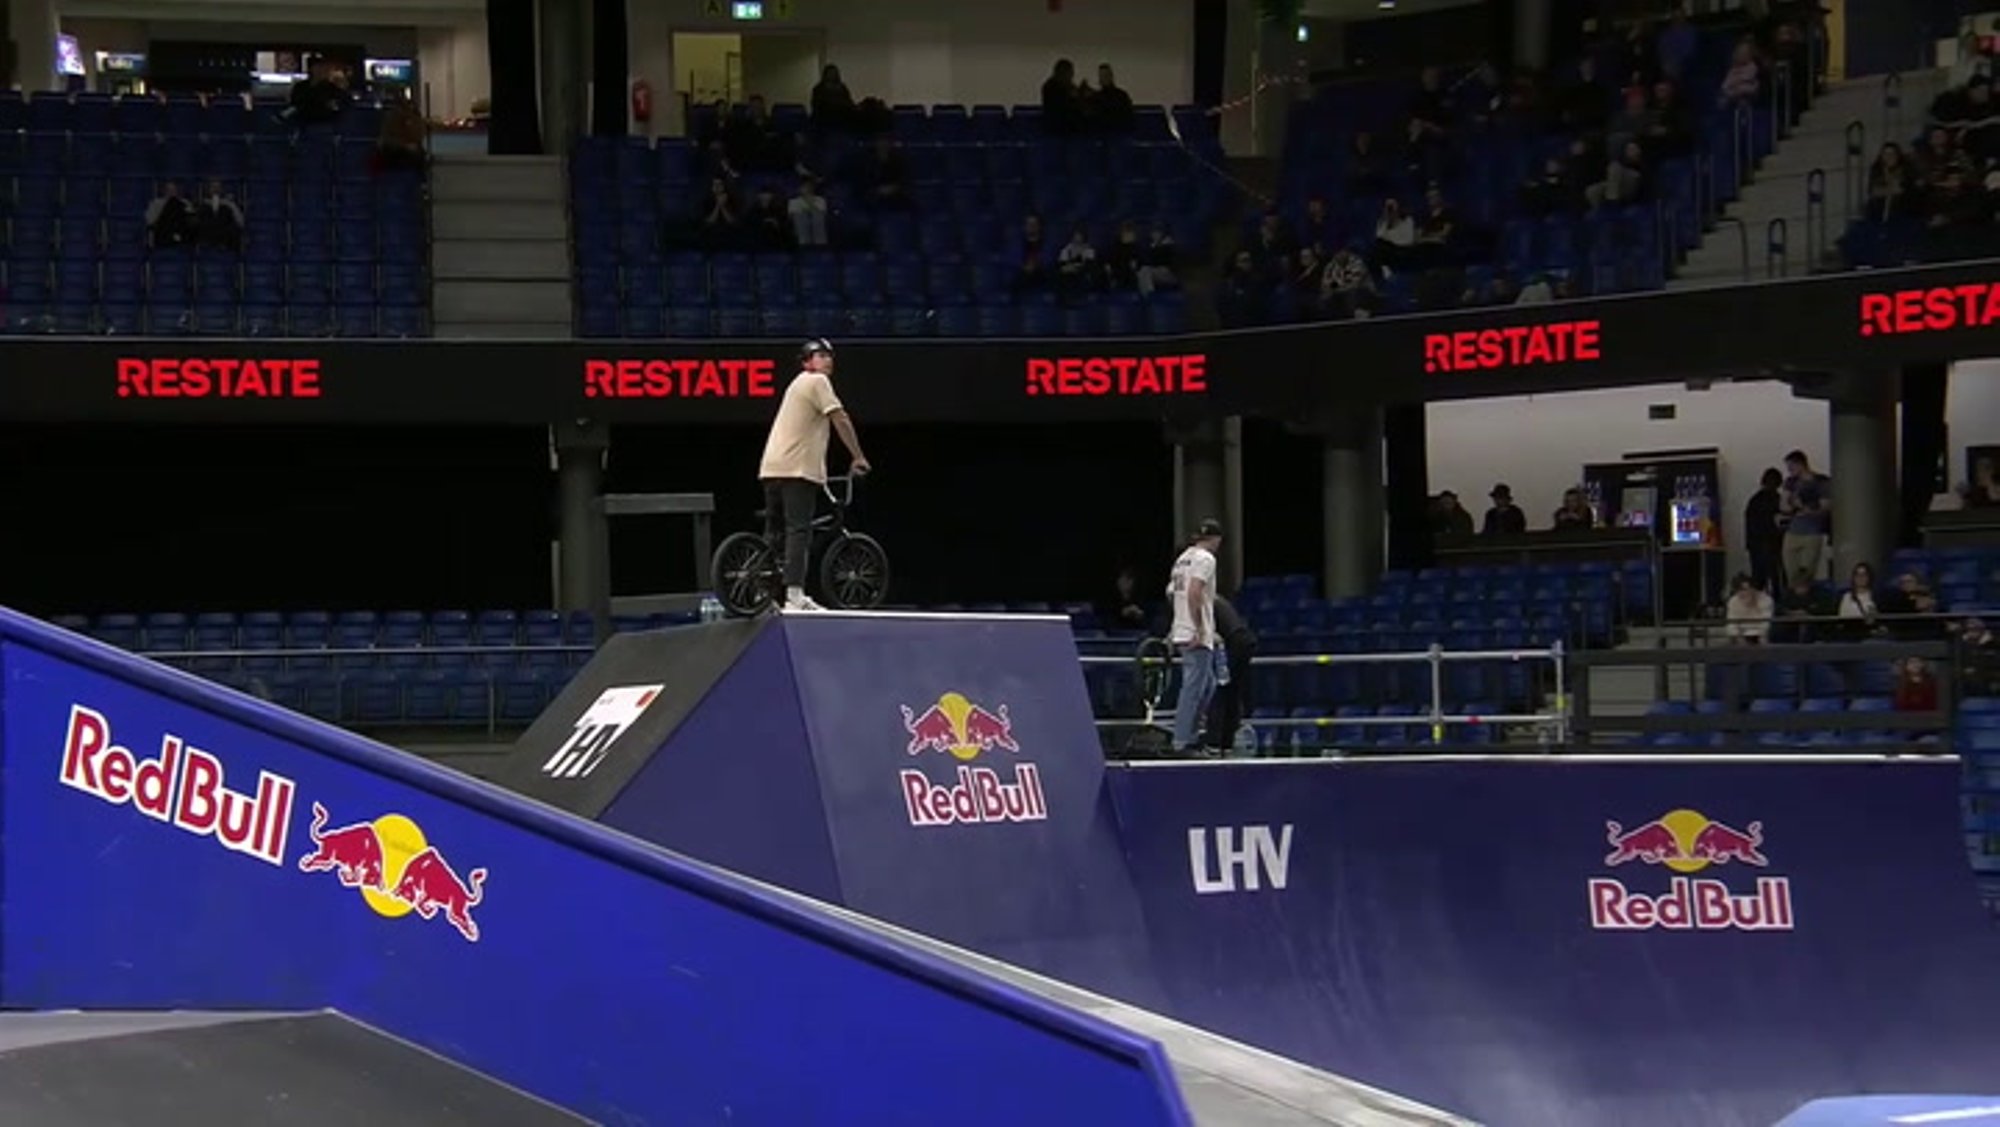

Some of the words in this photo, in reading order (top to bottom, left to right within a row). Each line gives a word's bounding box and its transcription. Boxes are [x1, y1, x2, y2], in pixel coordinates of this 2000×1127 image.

[1425, 320, 1600, 373] RESTATE
[117, 358, 320, 397] RESTATE
[585, 359, 775, 397] RESTATE
[1026, 354, 1206, 395] RESTATE
[60, 703, 183, 823] Red
[173, 746, 296, 866] Bull
[901, 765, 980, 825] Red
[972, 763, 1047, 822] Bull
[1189, 824, 1293, 893] LHV
[1588, 877, 1693, 929] Red
[1692, 877, 1794, 930] Bull
